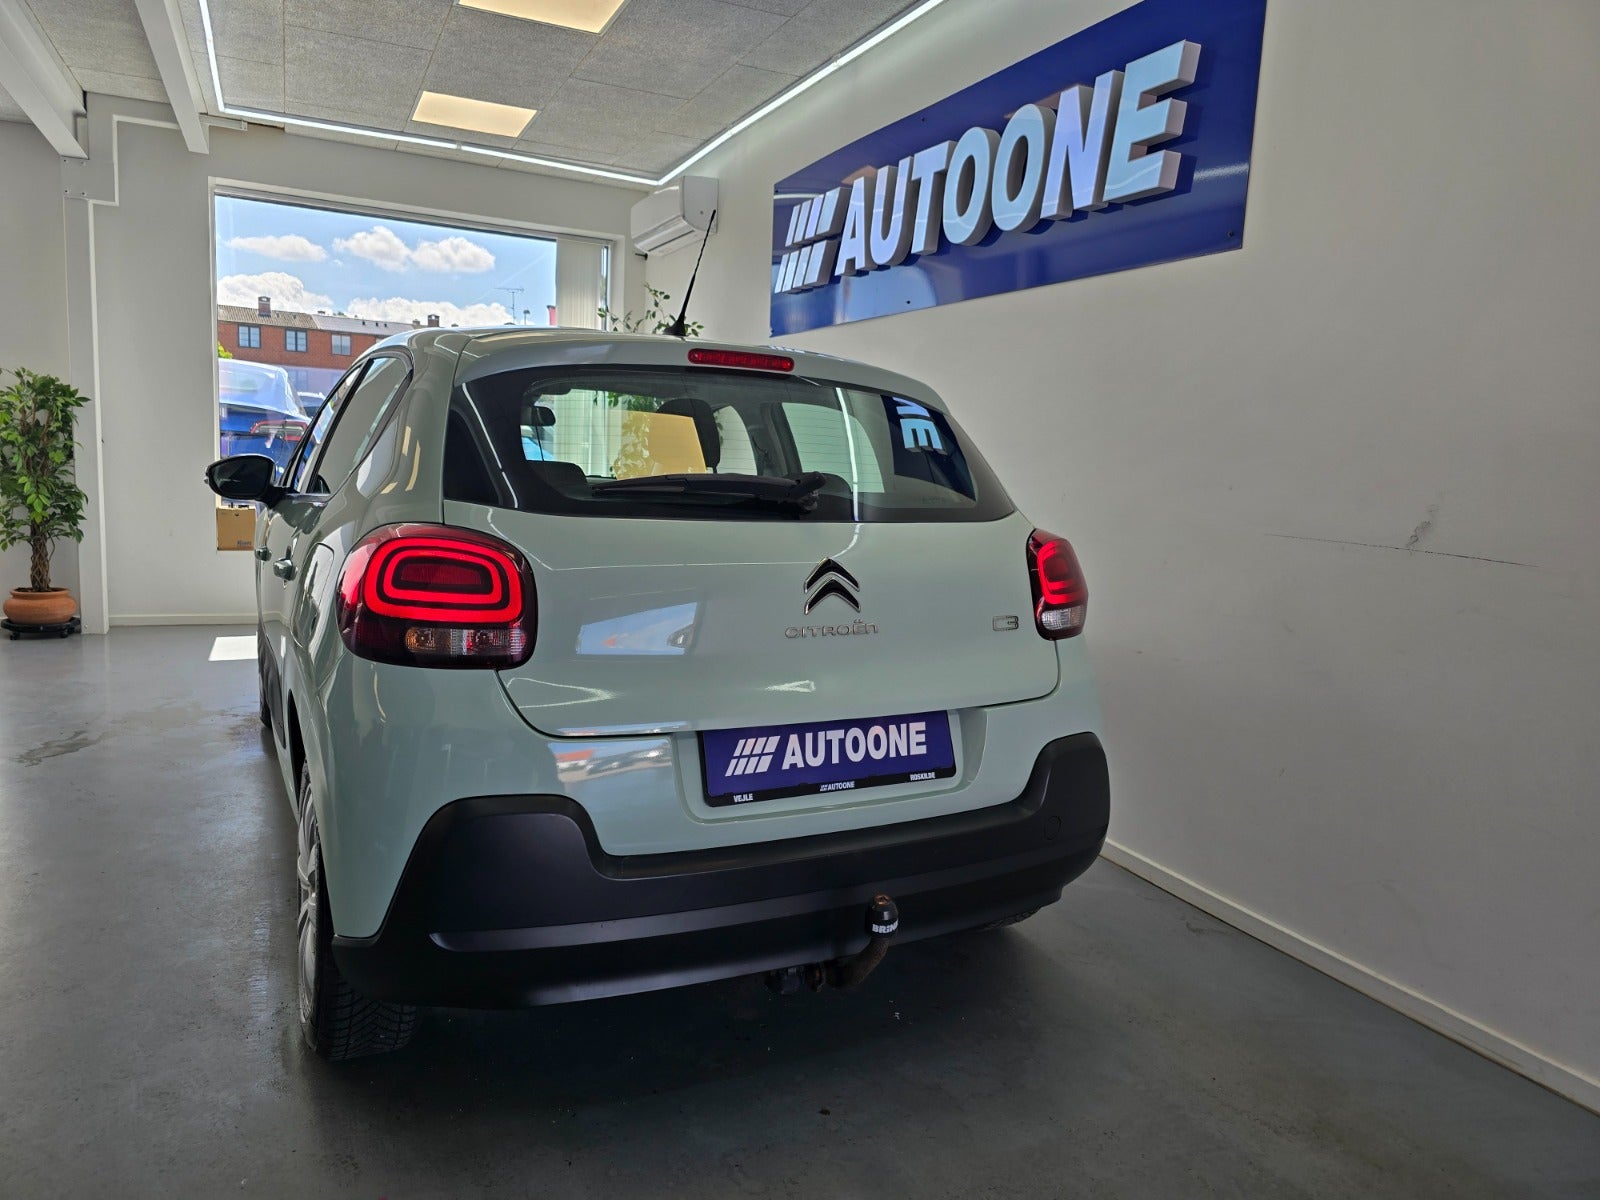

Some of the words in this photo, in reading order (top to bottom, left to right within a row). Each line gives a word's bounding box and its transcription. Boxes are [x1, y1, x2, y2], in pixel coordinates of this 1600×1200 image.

[835, 39, 1200, 276] AUTOONE
[992, 615, 1019, 631] C3
[781, 721, 927, 770] AUTOONE
[910, 772, 935, 781] ROSKILDE
[827, 781, 855, 791] AUTOONE
[733, 794, 753, 803] VEJLE
